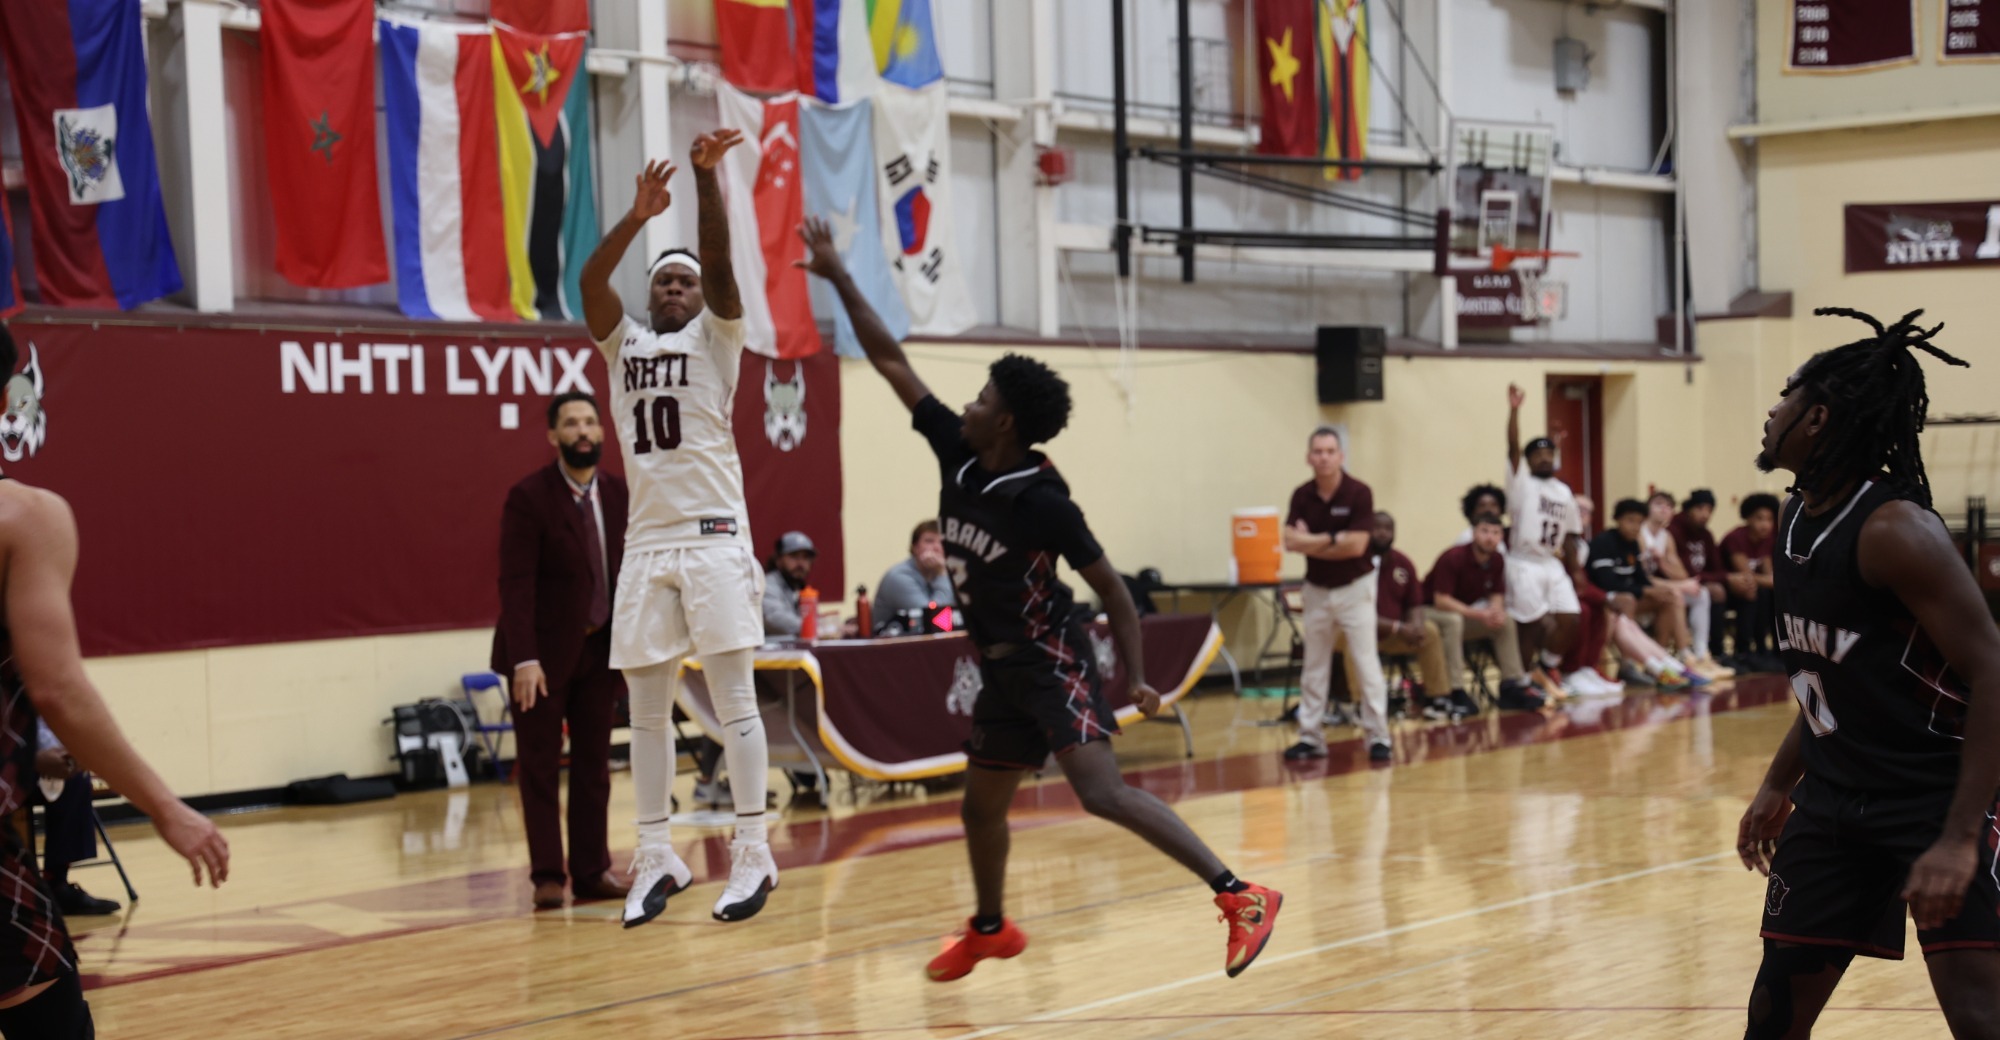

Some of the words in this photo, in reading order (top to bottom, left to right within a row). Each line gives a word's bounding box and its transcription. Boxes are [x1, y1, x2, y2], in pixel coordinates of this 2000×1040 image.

[1885, 239, 1960, 264] NHTI
[280, 341, 425, 394] NHTI
[446, 345, 595, 395] LYNX
[623, 353, 689, 393] NHTI
[633, 396, 682, 454] 10
[1775, 612, 1861, 664] LBANY
[1790, 669, 1838, 737] 0
